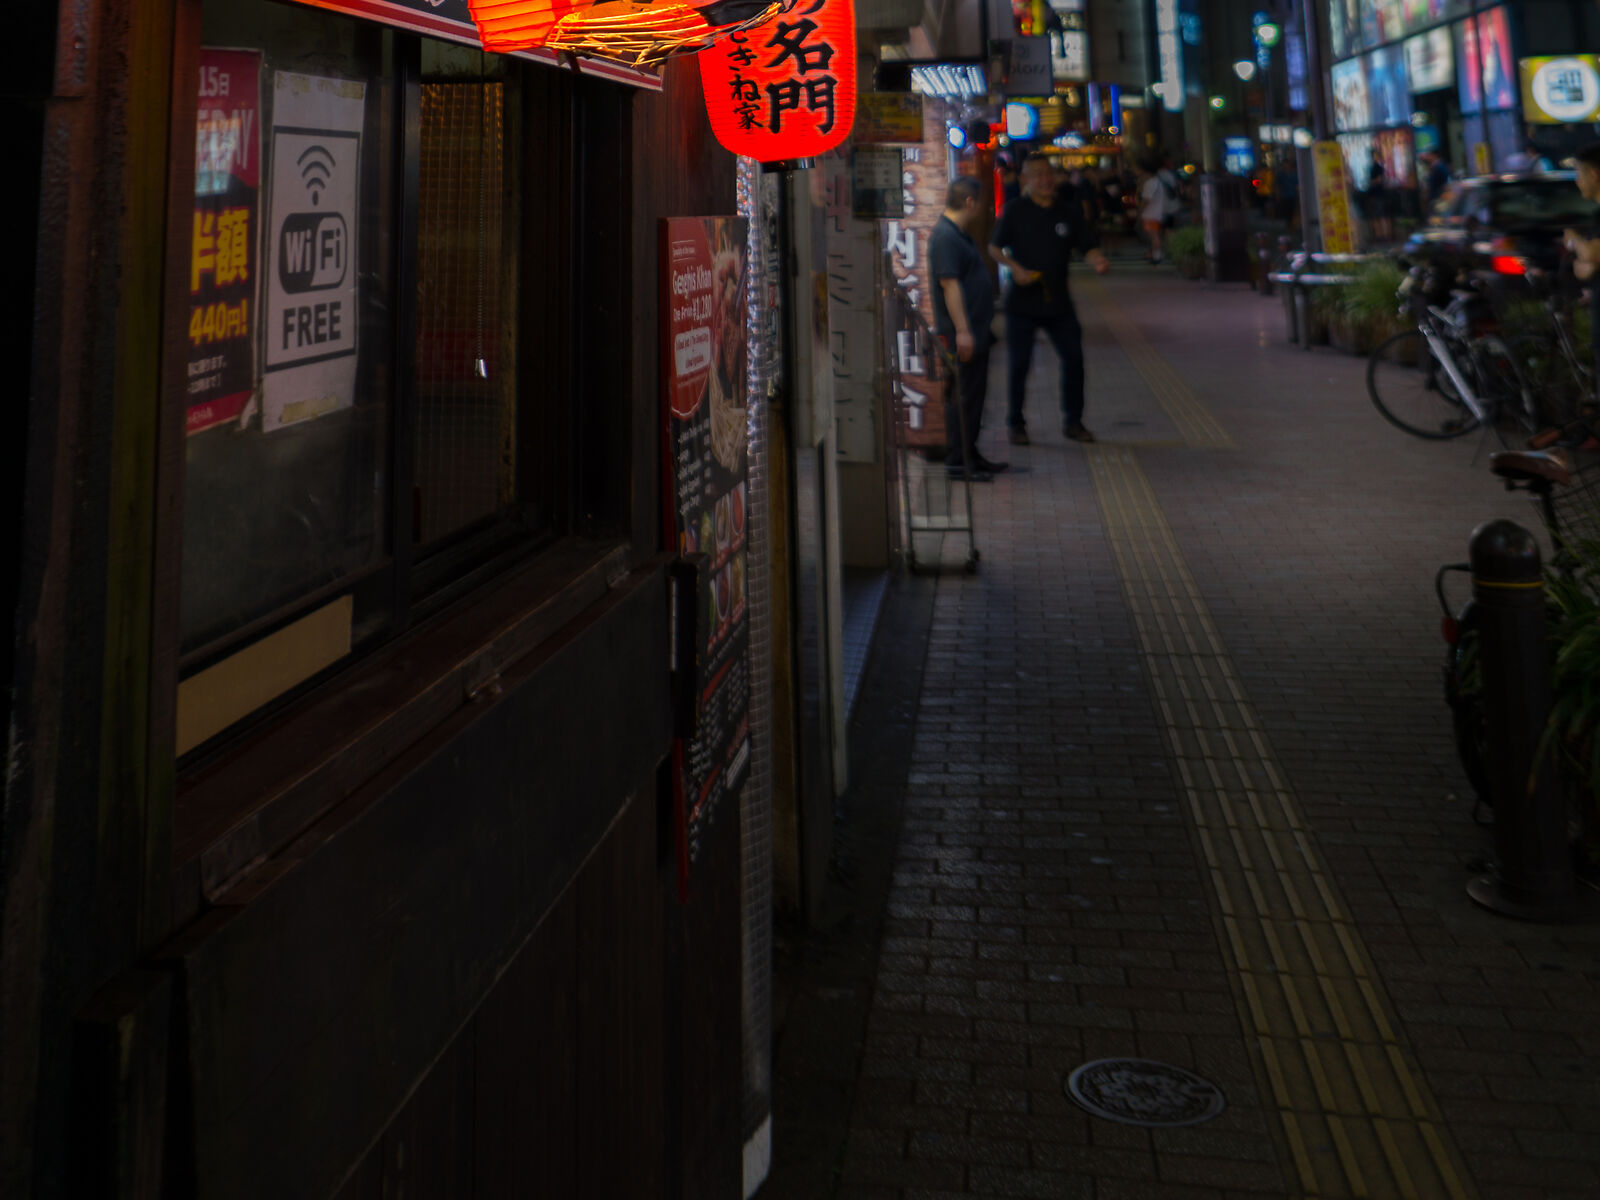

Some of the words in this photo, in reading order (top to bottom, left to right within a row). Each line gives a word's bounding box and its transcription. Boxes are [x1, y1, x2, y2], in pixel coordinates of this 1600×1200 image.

[672, 263, 696, 299] Genghis
[696, 264, 712, 291] Khan
[282, 301, 342, 351] FREE
